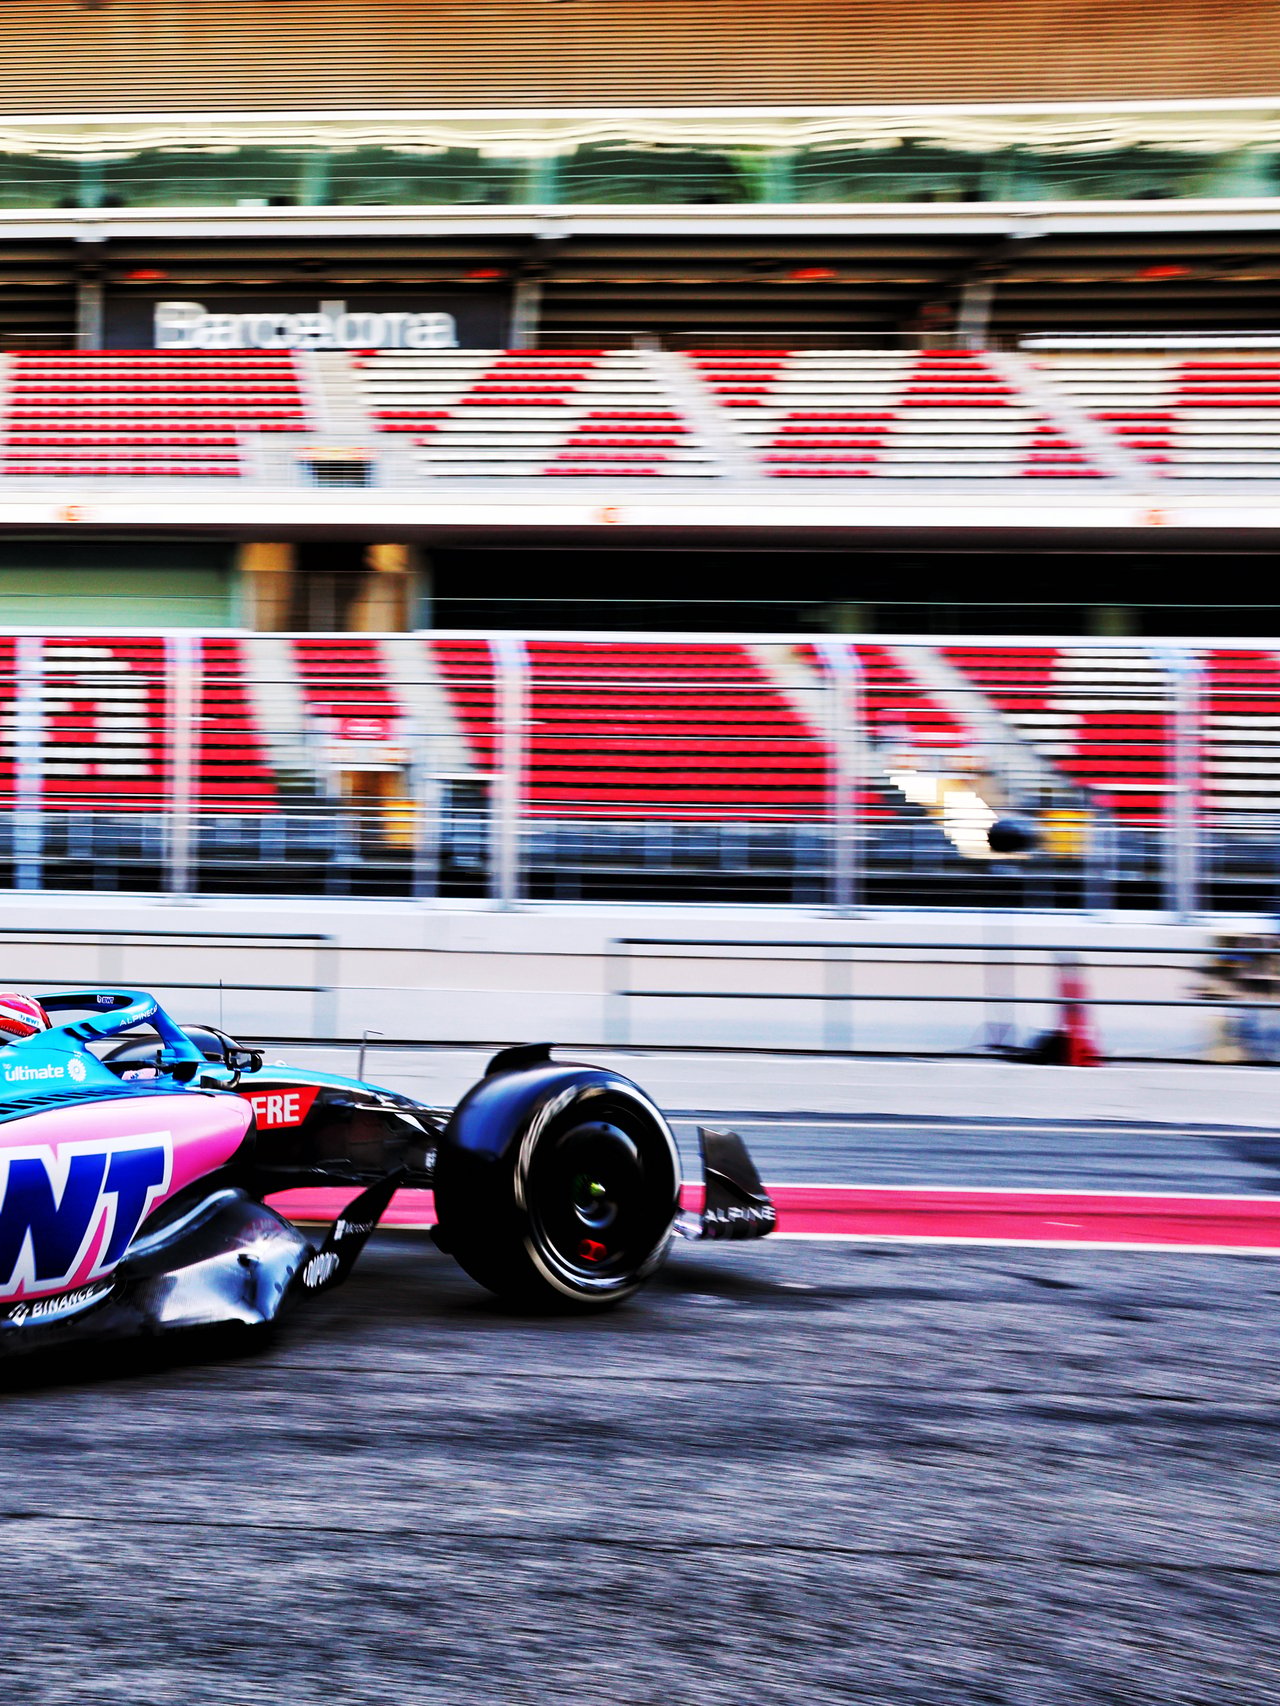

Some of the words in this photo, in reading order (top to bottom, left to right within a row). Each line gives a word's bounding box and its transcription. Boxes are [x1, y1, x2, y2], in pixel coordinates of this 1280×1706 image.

[154, 300, 458, 350] Barcelona
[5, 1064, 64, 1081] ultimate
[251, 1093, 300, 1124] FRE
[703, 1204, 777, 1222] ALPINE
[31, 1286, 95, 1318] BINANCE
